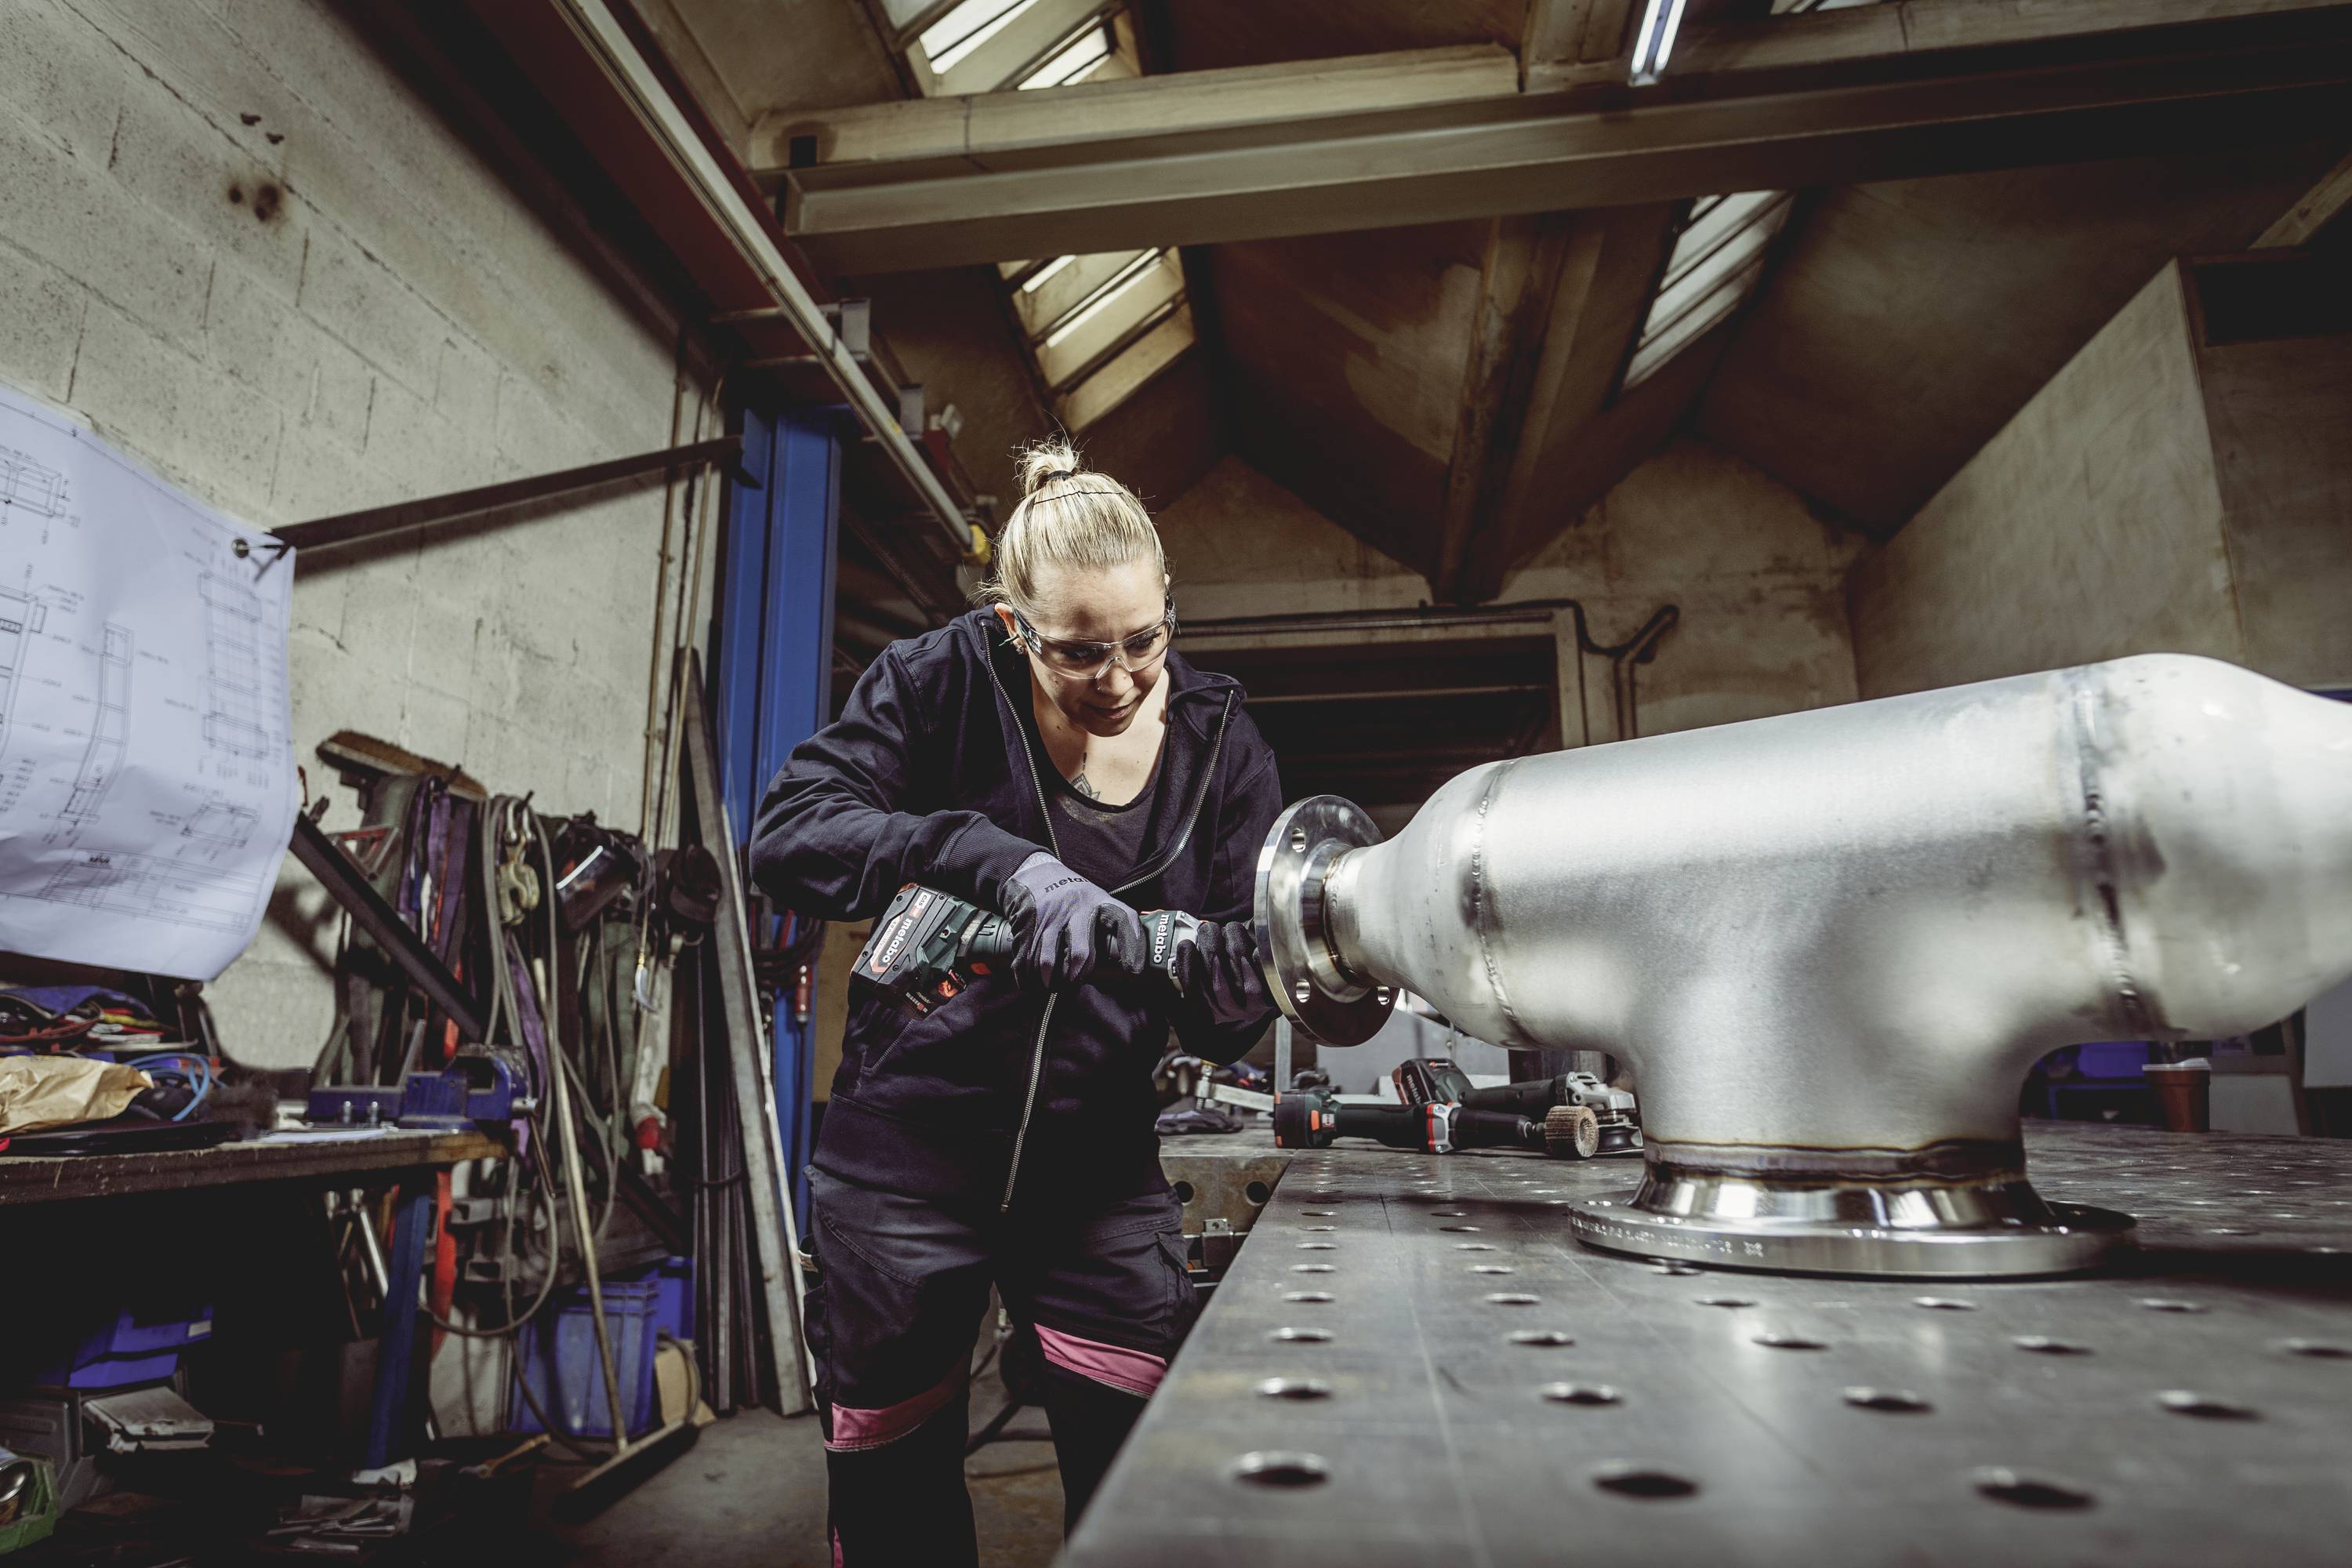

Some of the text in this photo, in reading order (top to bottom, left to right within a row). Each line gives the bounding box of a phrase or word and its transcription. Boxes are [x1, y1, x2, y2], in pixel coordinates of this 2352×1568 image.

[1044, 877, 1089, 893] meta
[882, 917, 913, 964] metabo
[1153, 914, 1170, 964] metabo
[1406, 1074, 1421, 1104] metab
